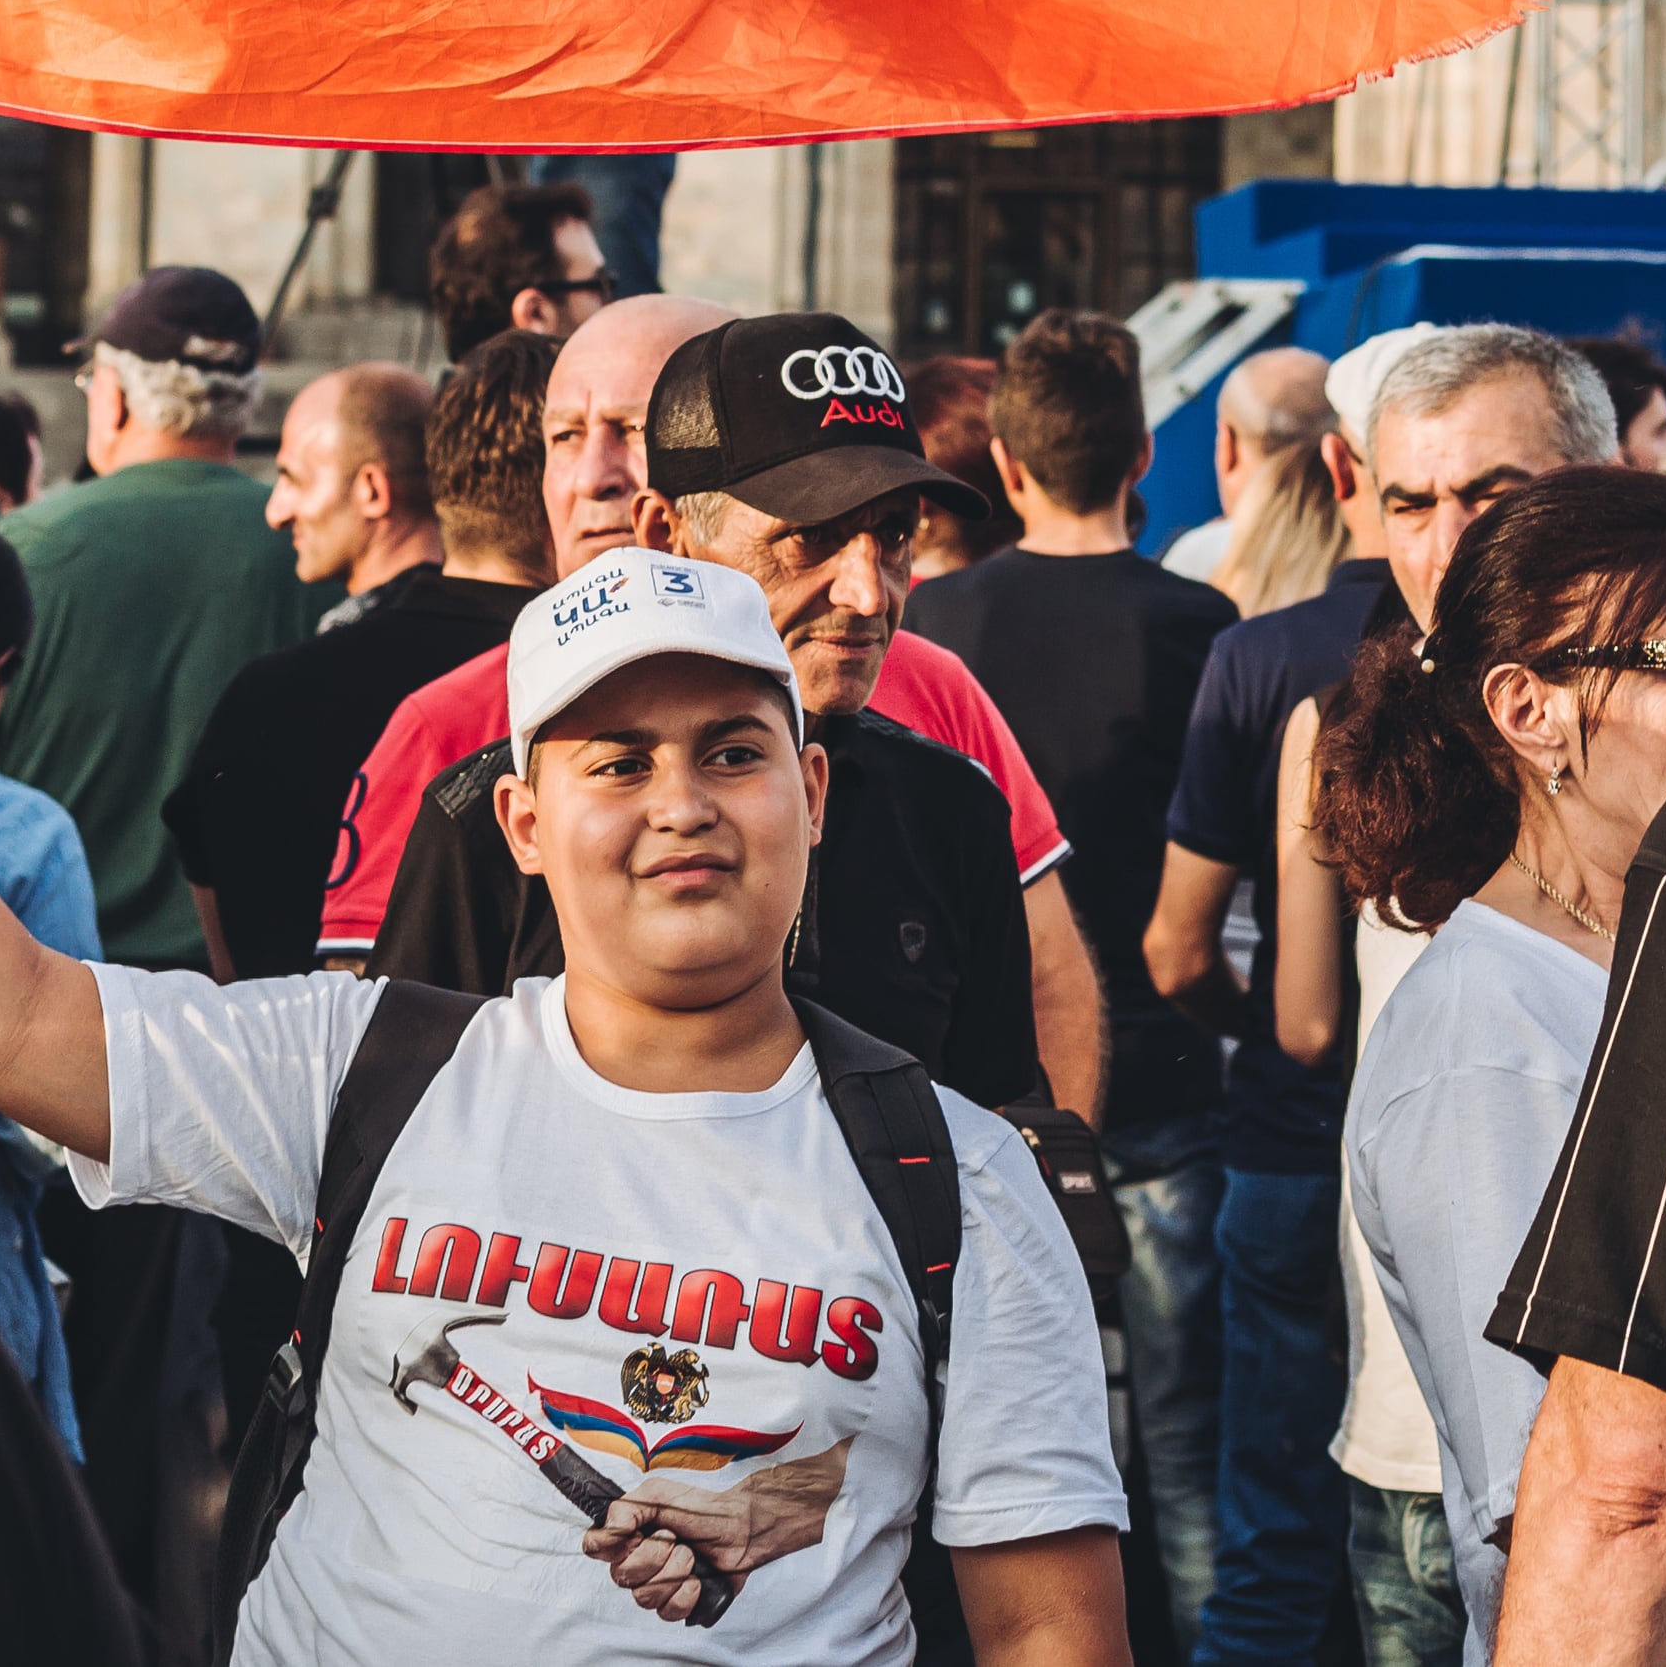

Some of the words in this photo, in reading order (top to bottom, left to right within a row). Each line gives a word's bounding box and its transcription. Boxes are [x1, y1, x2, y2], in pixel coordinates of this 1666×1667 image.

[820, 397, 906, 431] Audi
[661, 570, 695, 594] 3
[370, 1216, 884, 1382] ԼՈՒՍԱՌԱՏ
[450, 1366, 556, 1461] ԱՐԱՐԱՏ
